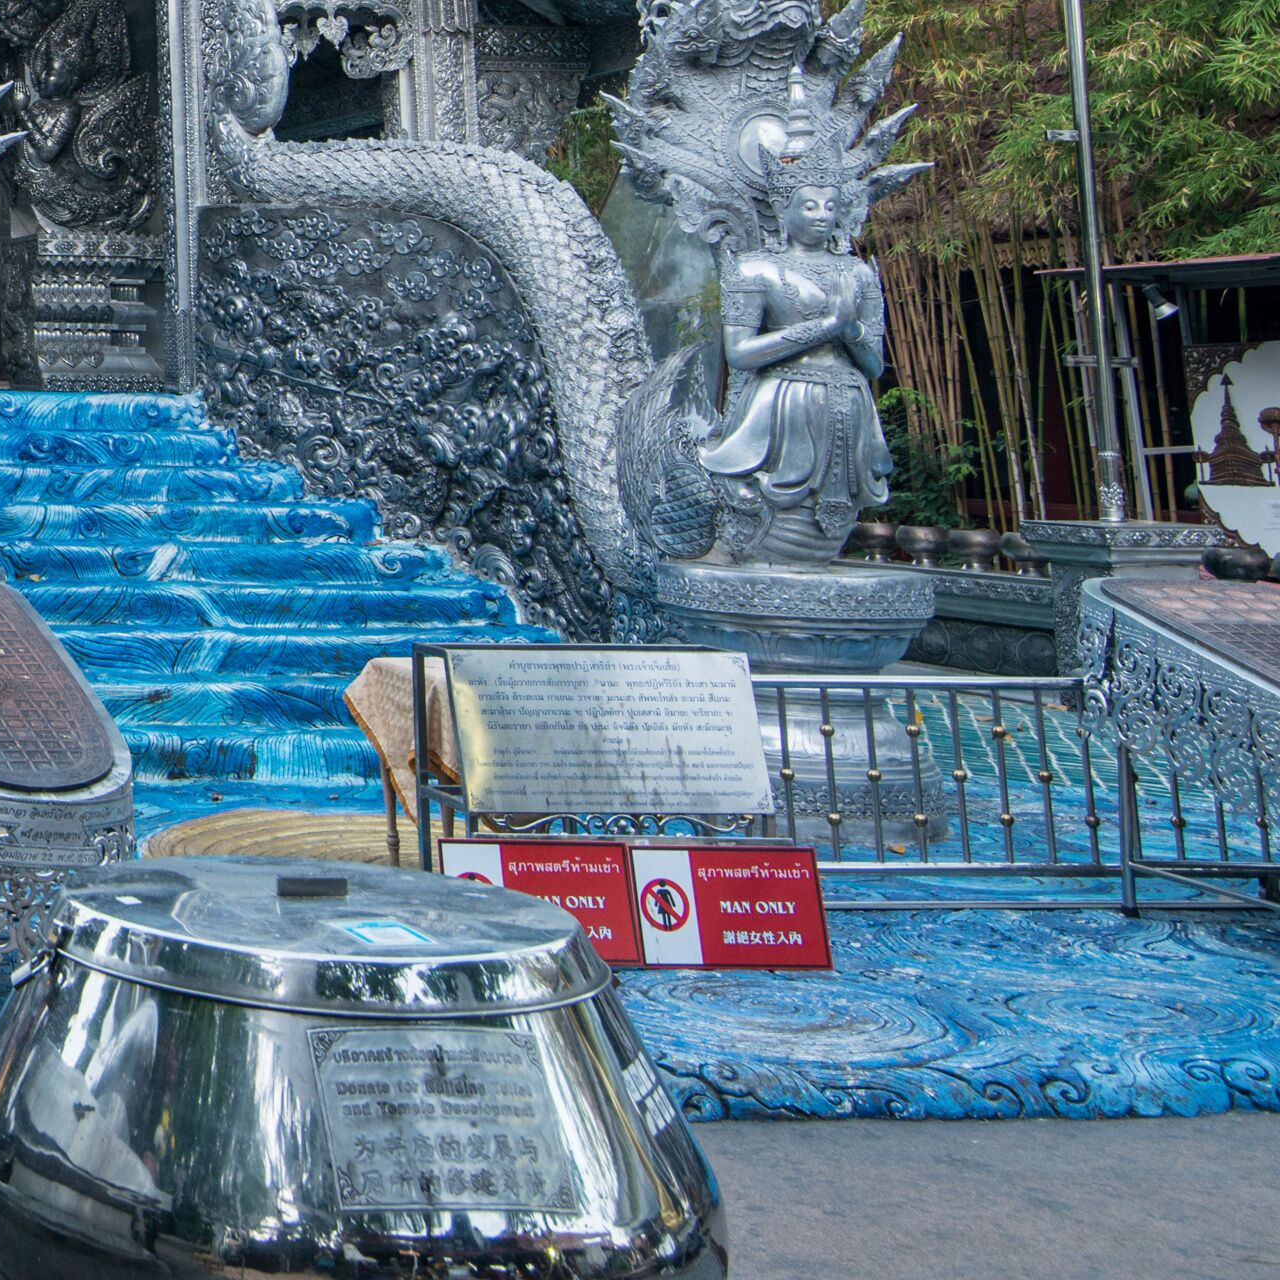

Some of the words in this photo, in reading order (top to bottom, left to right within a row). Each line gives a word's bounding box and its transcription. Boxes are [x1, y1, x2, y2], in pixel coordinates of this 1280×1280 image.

[508, 856, 620, 875] สุภาพสตรีห้ามเข้า
[697, 862, 810, 881] สุภาพสตรีห้ามเข้า
[566, 895, 606, 909] ONLY
[720, 901, 752, 914] MAN
[755, 901, 796, 915] ONLY
[336, 1080, 390, 1096] Donate
[397, 1081, 419, 1094] for
[425, 1078, 486, 1097] Building
[342, 1102, 372, 1117] and
[377, 1101, 436, 1118] Temple
[440, 1101, 536, 1118] Development
